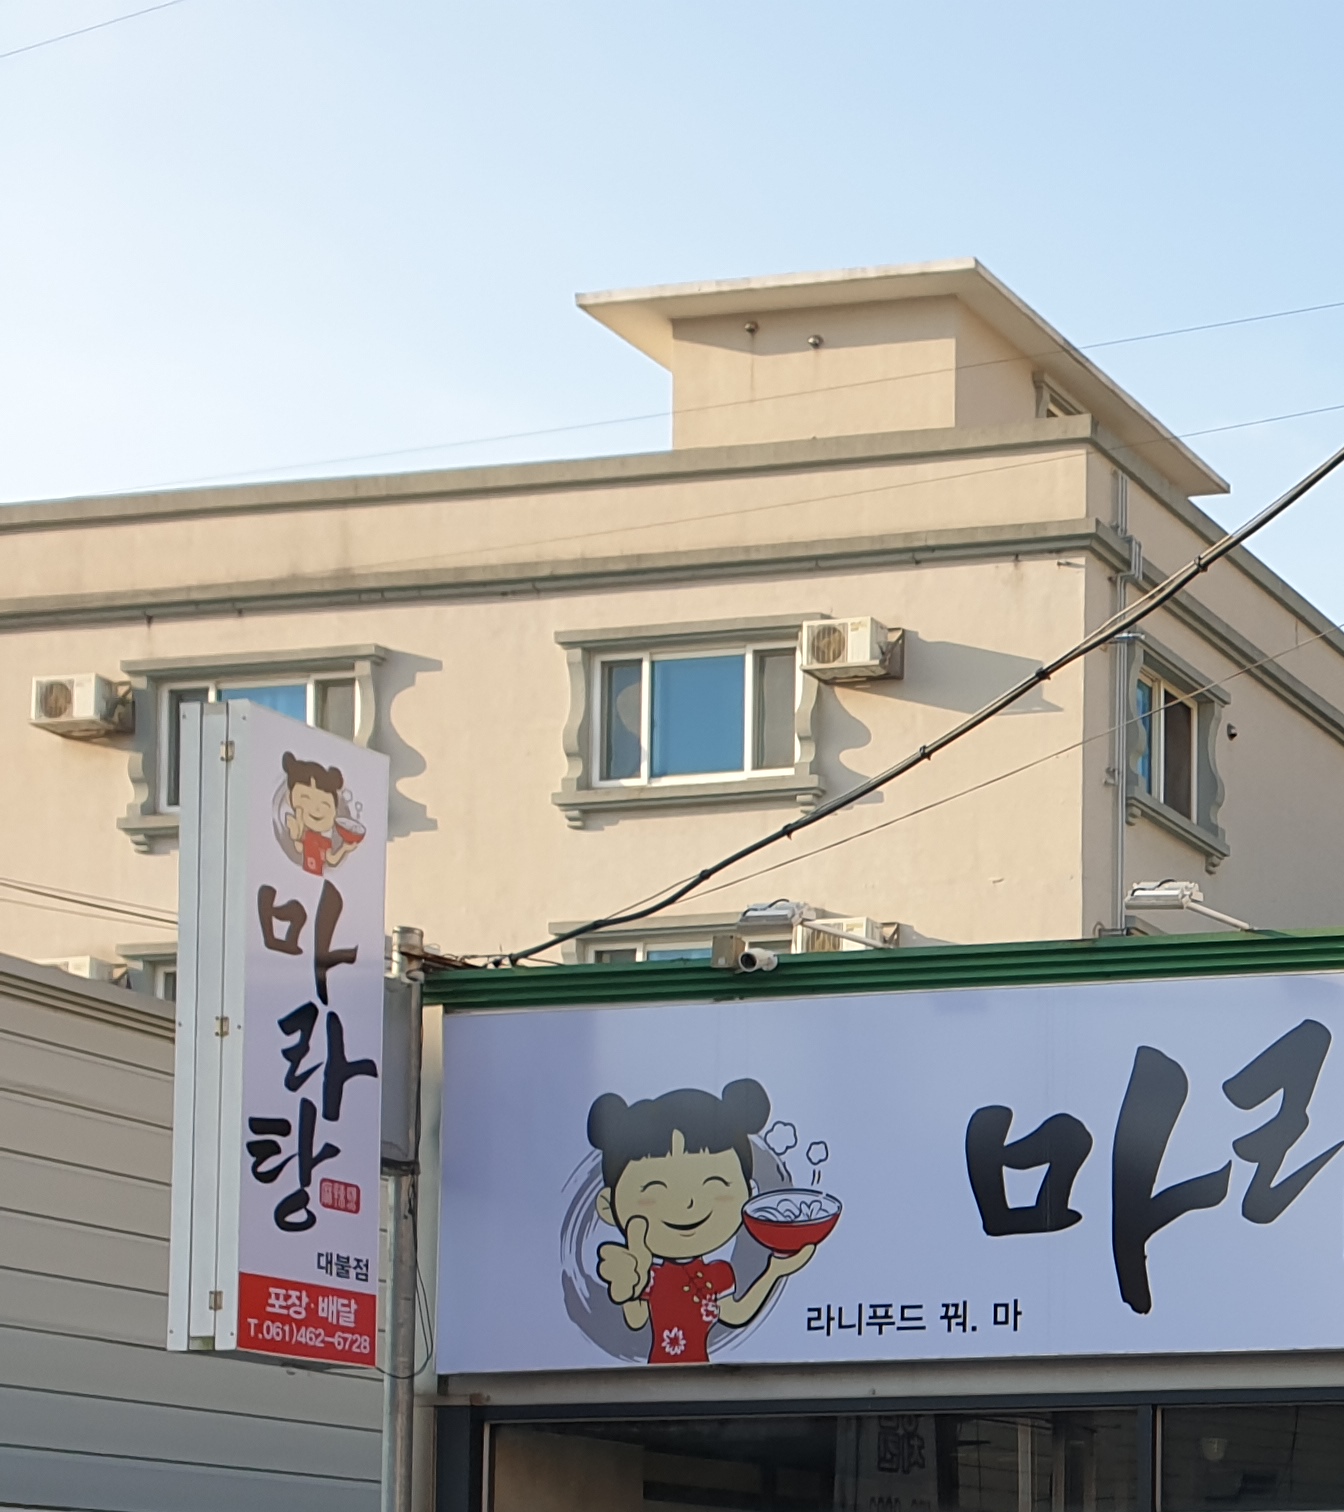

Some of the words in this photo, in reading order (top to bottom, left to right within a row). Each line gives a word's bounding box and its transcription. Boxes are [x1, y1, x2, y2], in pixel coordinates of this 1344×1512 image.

[246, 879, 378, 1232] 마라탕
[316, 1251, 370, 1283] 대불점
[246, 1317, 371, 1354] T.061)462-6728
[806, 1302, 927, 1337] 라니푸드
[992, 1298, 1023, 1332] 마
